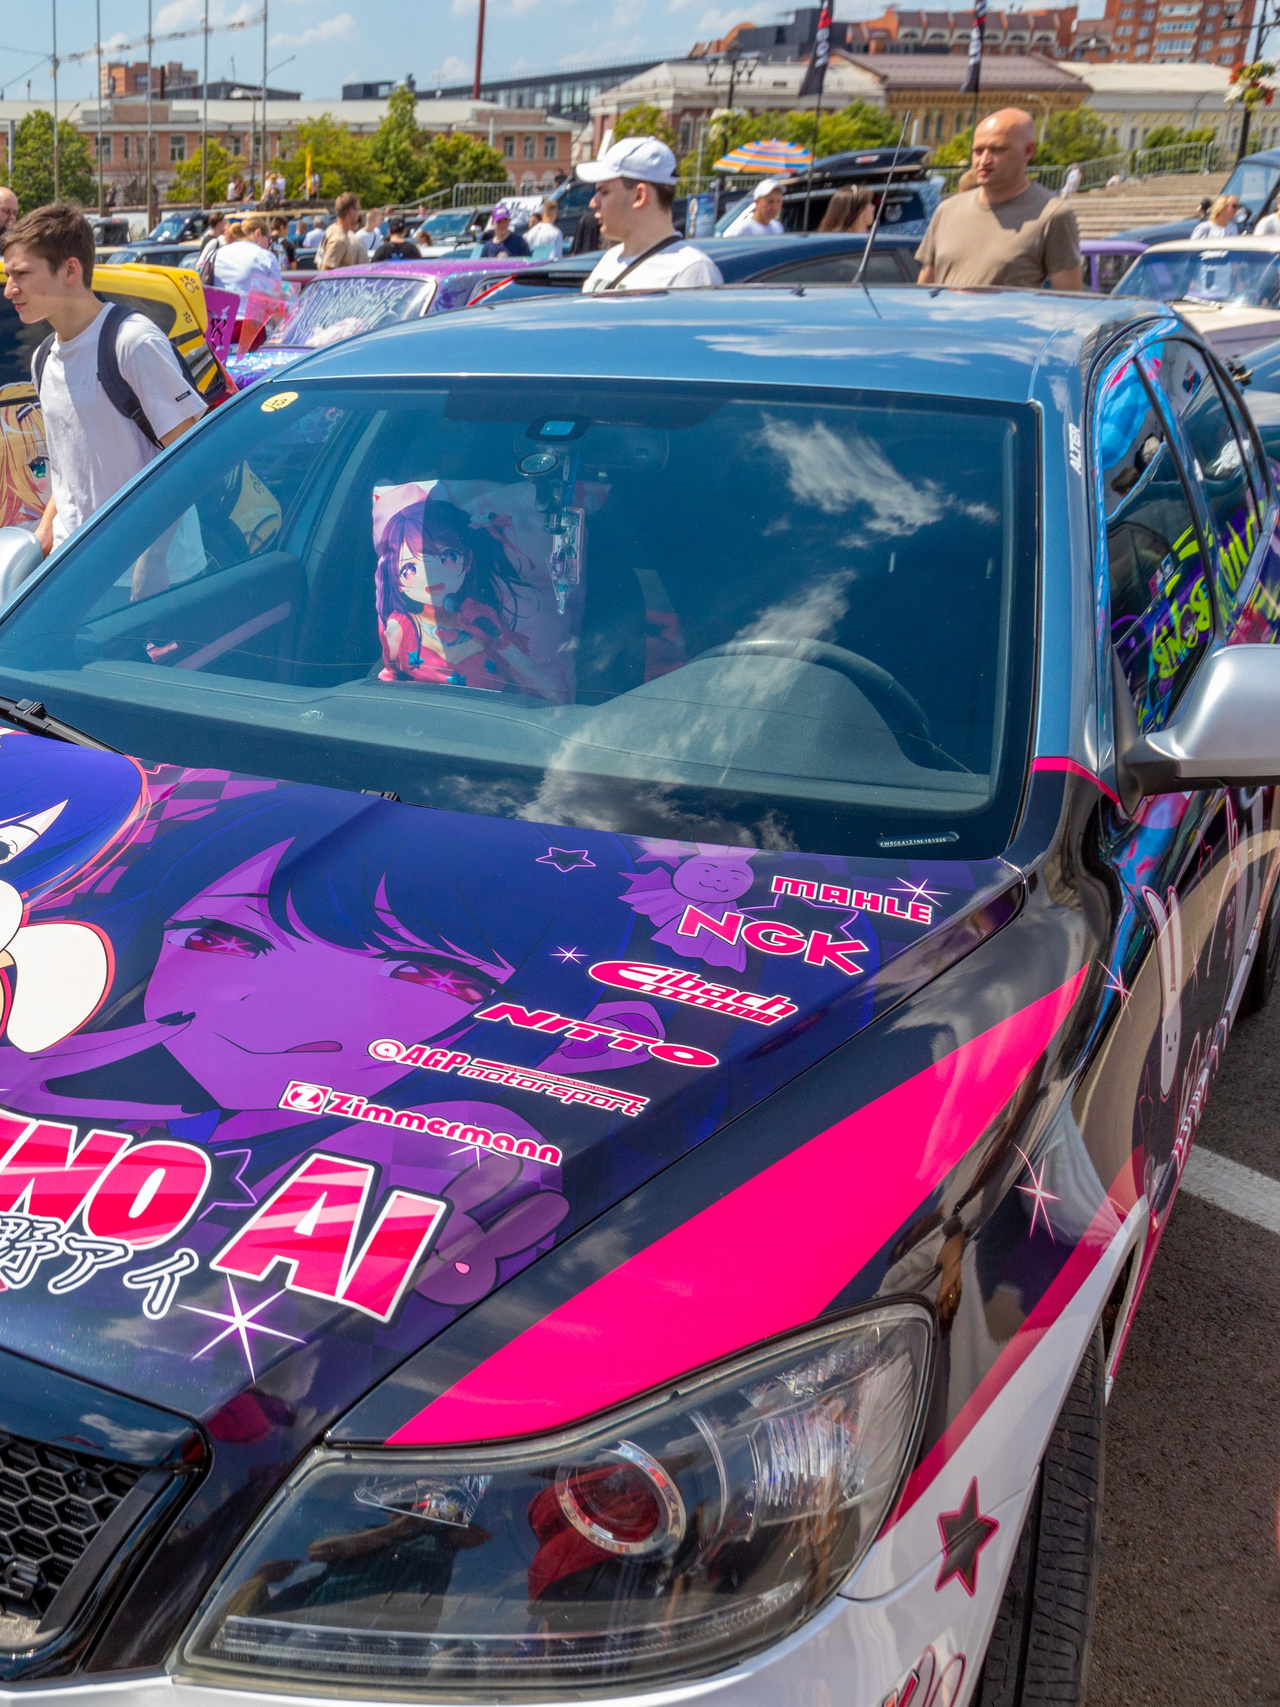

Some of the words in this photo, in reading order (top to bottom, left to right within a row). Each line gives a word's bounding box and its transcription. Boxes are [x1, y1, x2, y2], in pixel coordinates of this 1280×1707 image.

[770, 875, 934, 925] MAHLE
[677, 904, 869, 976] NGK
[588, 960, 799, 1026] Eibach
[397, 1043, 471, 1074] AGP
[474, 1001, 719, 1068] NITTO
[458, 1065, 644, 1117] motorsport
[327, 1091, 563, 1166] Zimmermann
[210, 1152, 447, 1324] AI
